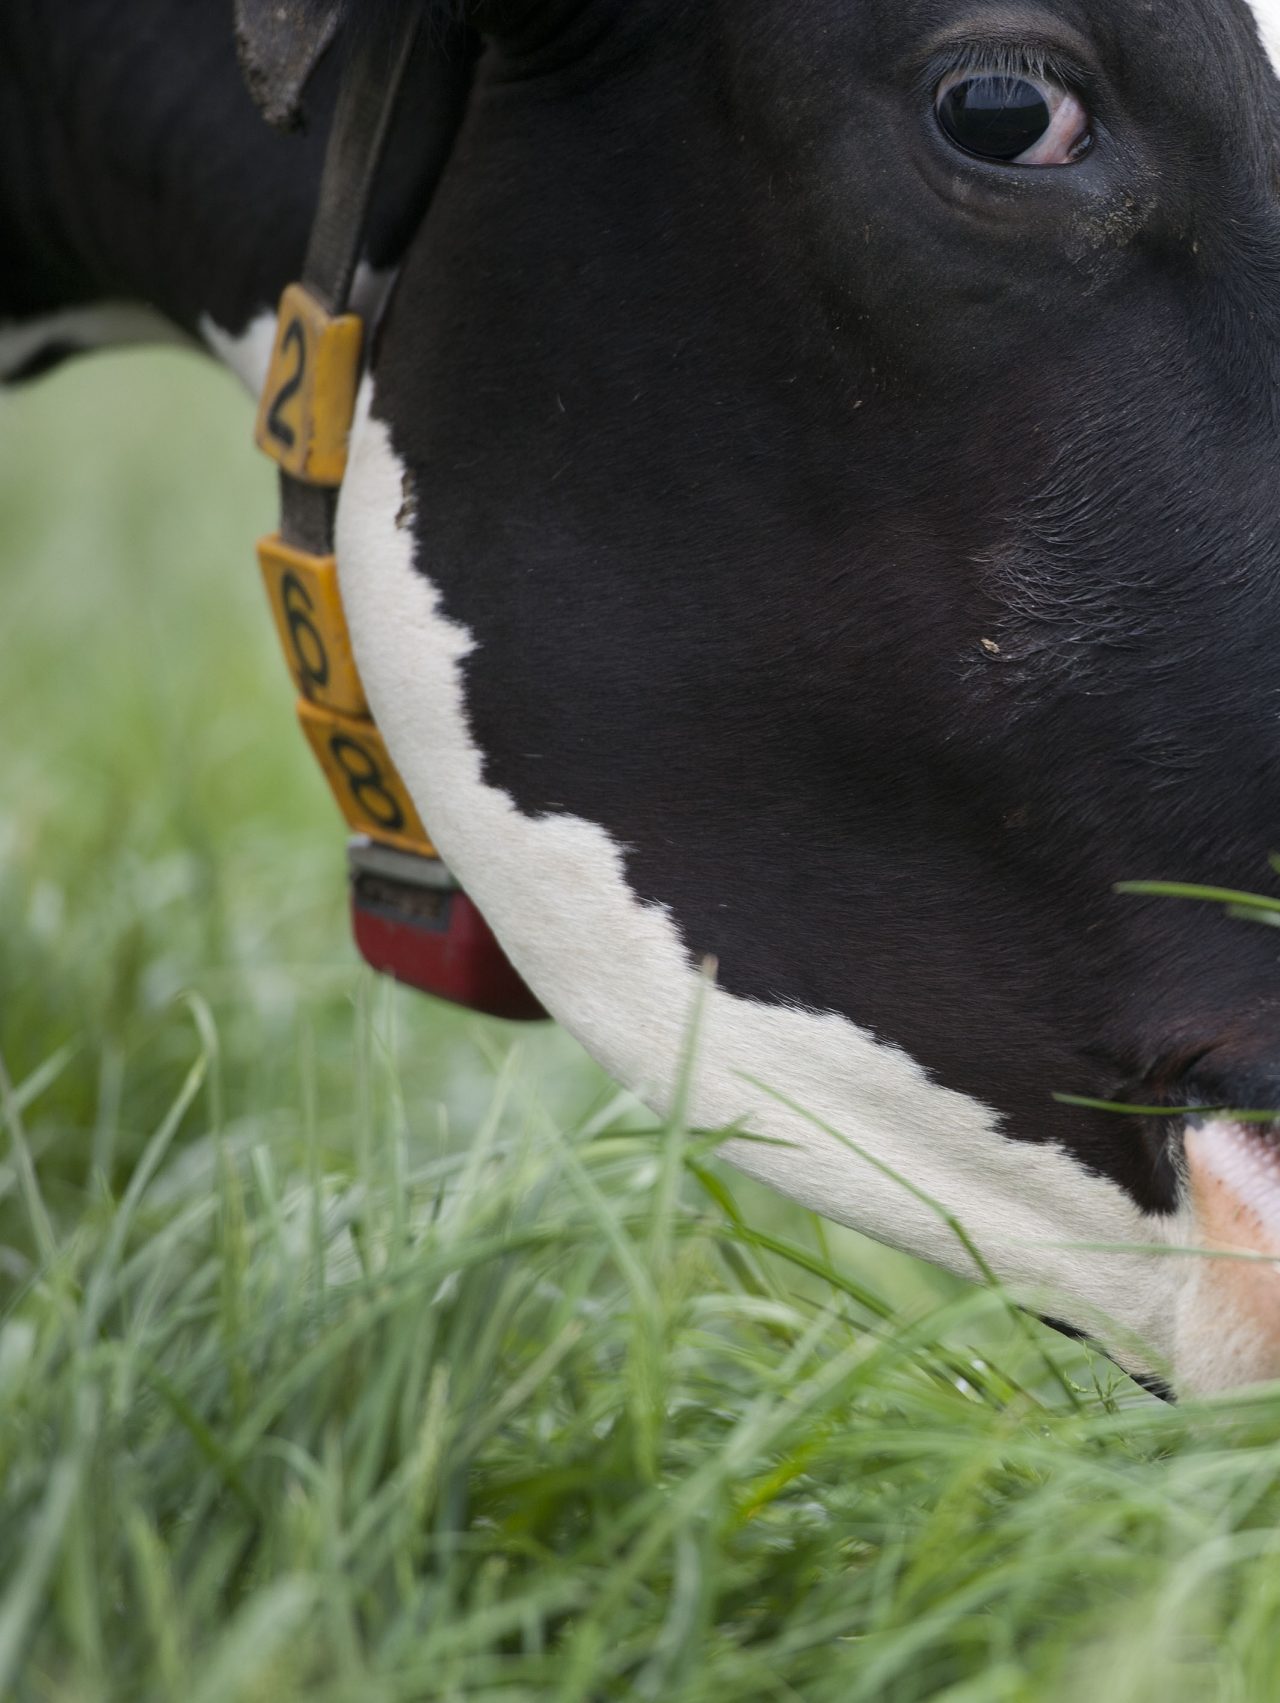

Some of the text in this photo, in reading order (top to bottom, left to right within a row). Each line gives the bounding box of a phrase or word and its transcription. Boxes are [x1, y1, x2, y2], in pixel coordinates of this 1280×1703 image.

[268, 318, 404, 831] 2 6 8
